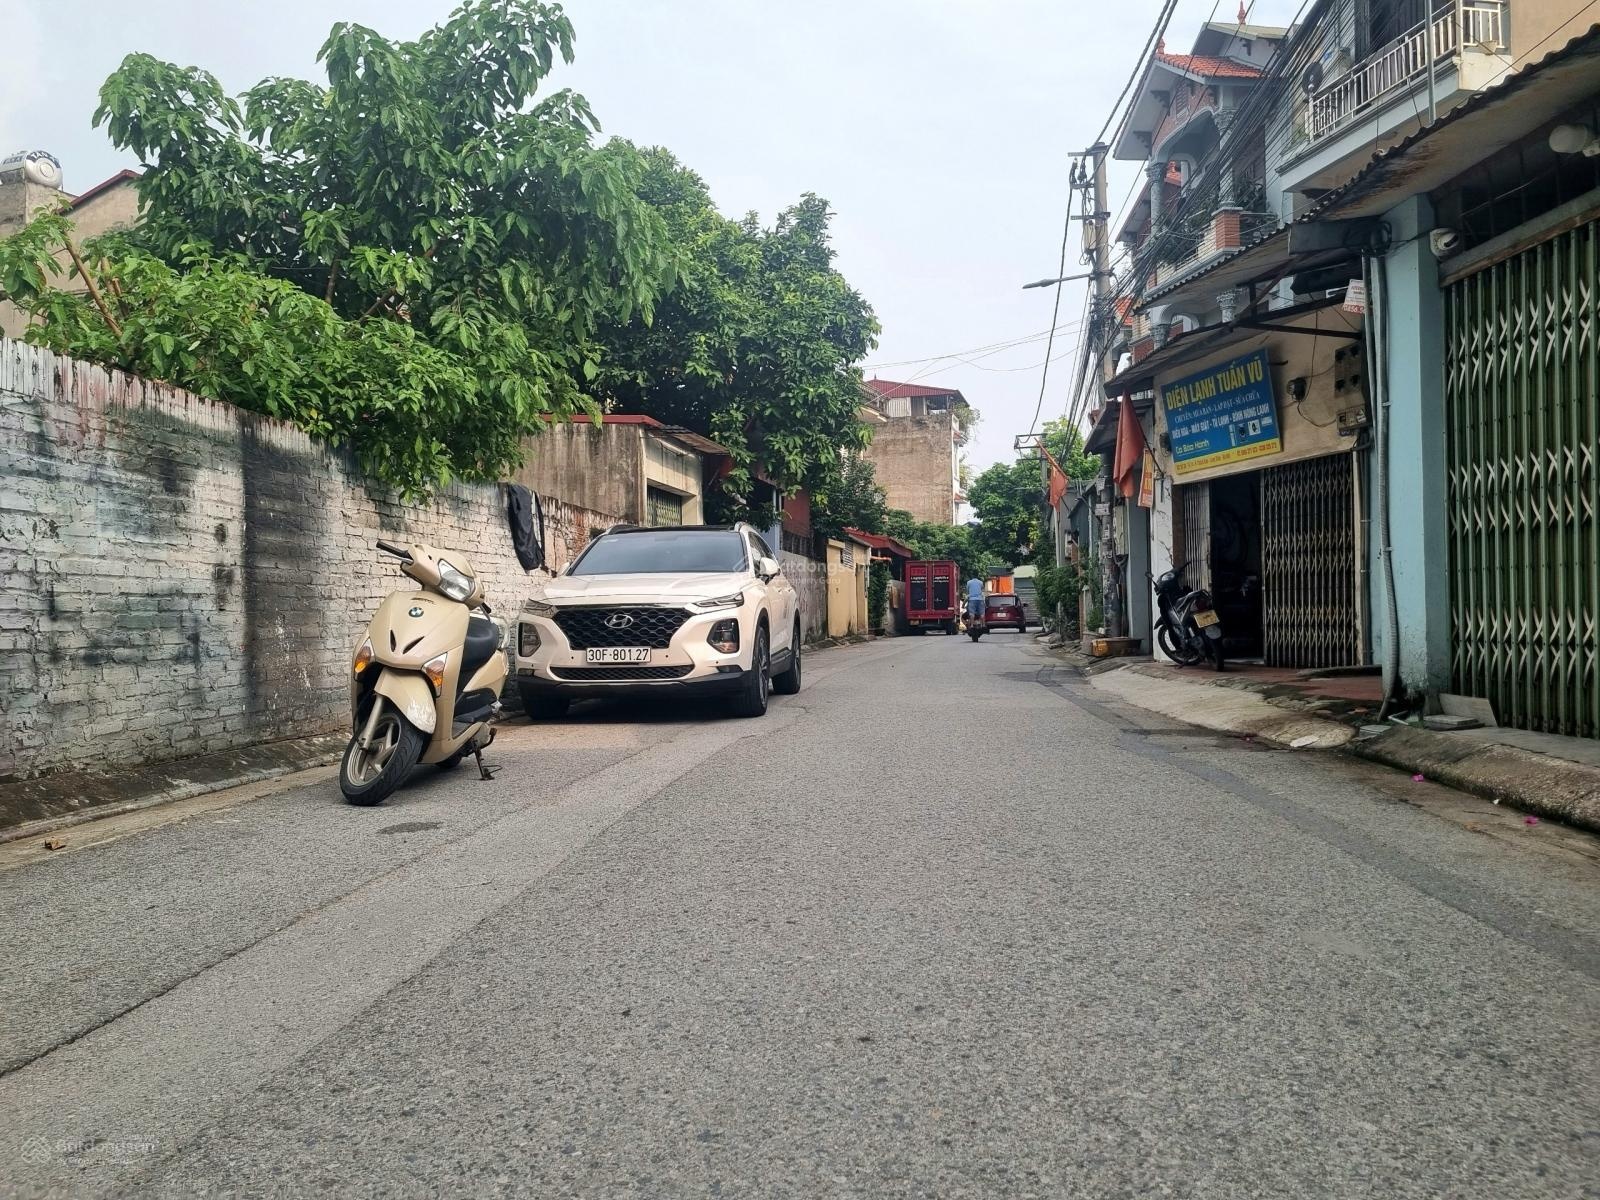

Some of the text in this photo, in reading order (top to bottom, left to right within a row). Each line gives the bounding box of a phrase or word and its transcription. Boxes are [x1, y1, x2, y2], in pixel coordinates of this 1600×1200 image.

[1166, 356, 1263, 411] ĐIỆN LẠNH TUẤN VŨ
